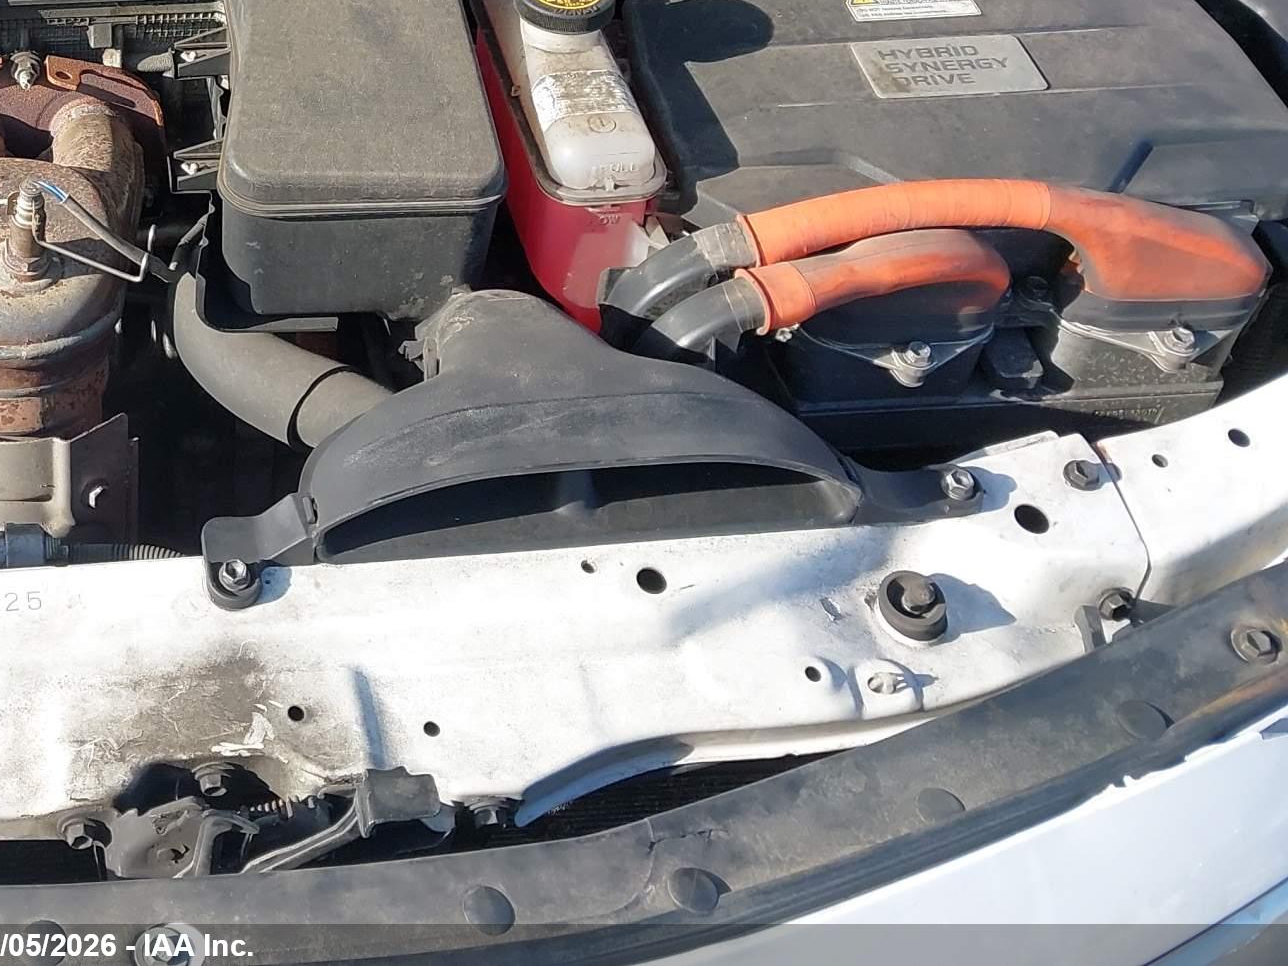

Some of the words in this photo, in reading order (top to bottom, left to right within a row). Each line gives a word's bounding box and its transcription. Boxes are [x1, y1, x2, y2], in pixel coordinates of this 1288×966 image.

[553, 5, 601, 17] DENSO
[878, 44, 979, 61] HYBRID
[885, 57, 1009, 74] SYNERGY
[893, 72, 976, 87] DRIVE
